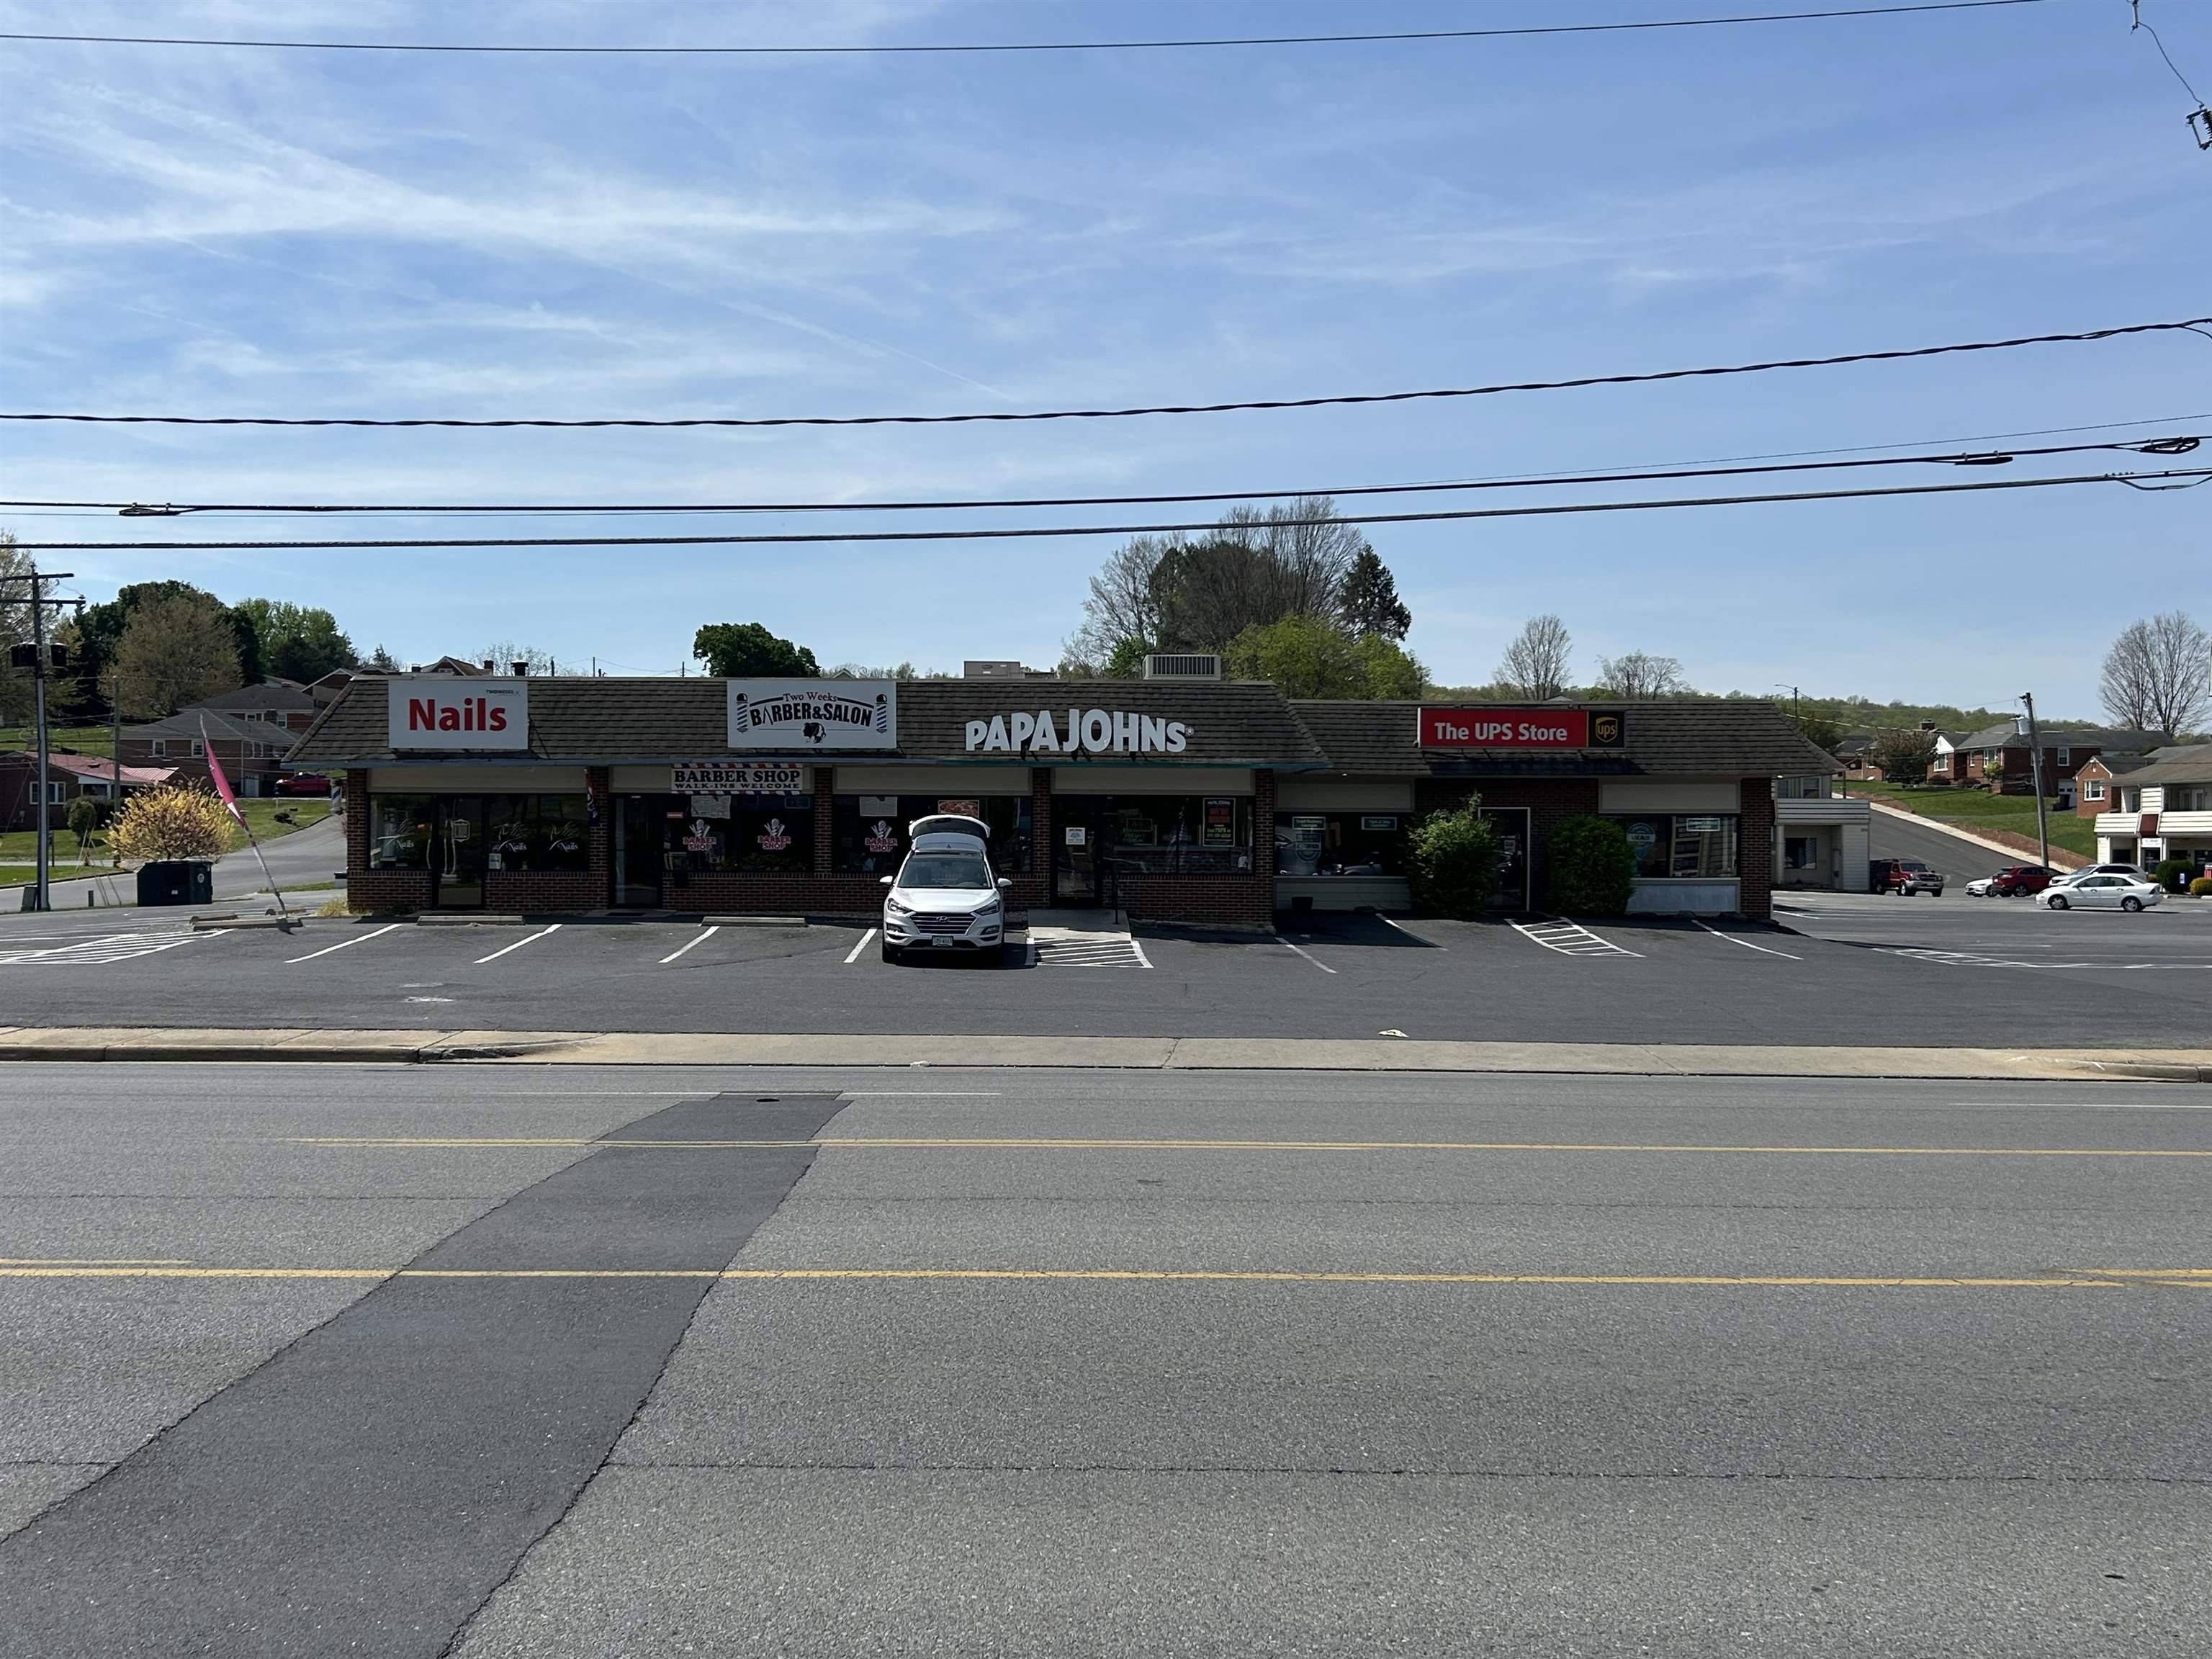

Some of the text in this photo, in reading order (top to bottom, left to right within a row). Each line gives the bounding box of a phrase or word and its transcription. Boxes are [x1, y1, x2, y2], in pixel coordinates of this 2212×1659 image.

[783, 692, 837, 702] Two Weeks
[409, 698, 507, 731] Nails
[966, 710, 1060, 752] PAPA
[1434, 722, 1568, 742] The UPS Store
[674, 770, 801, 783] BARBER SHOP
